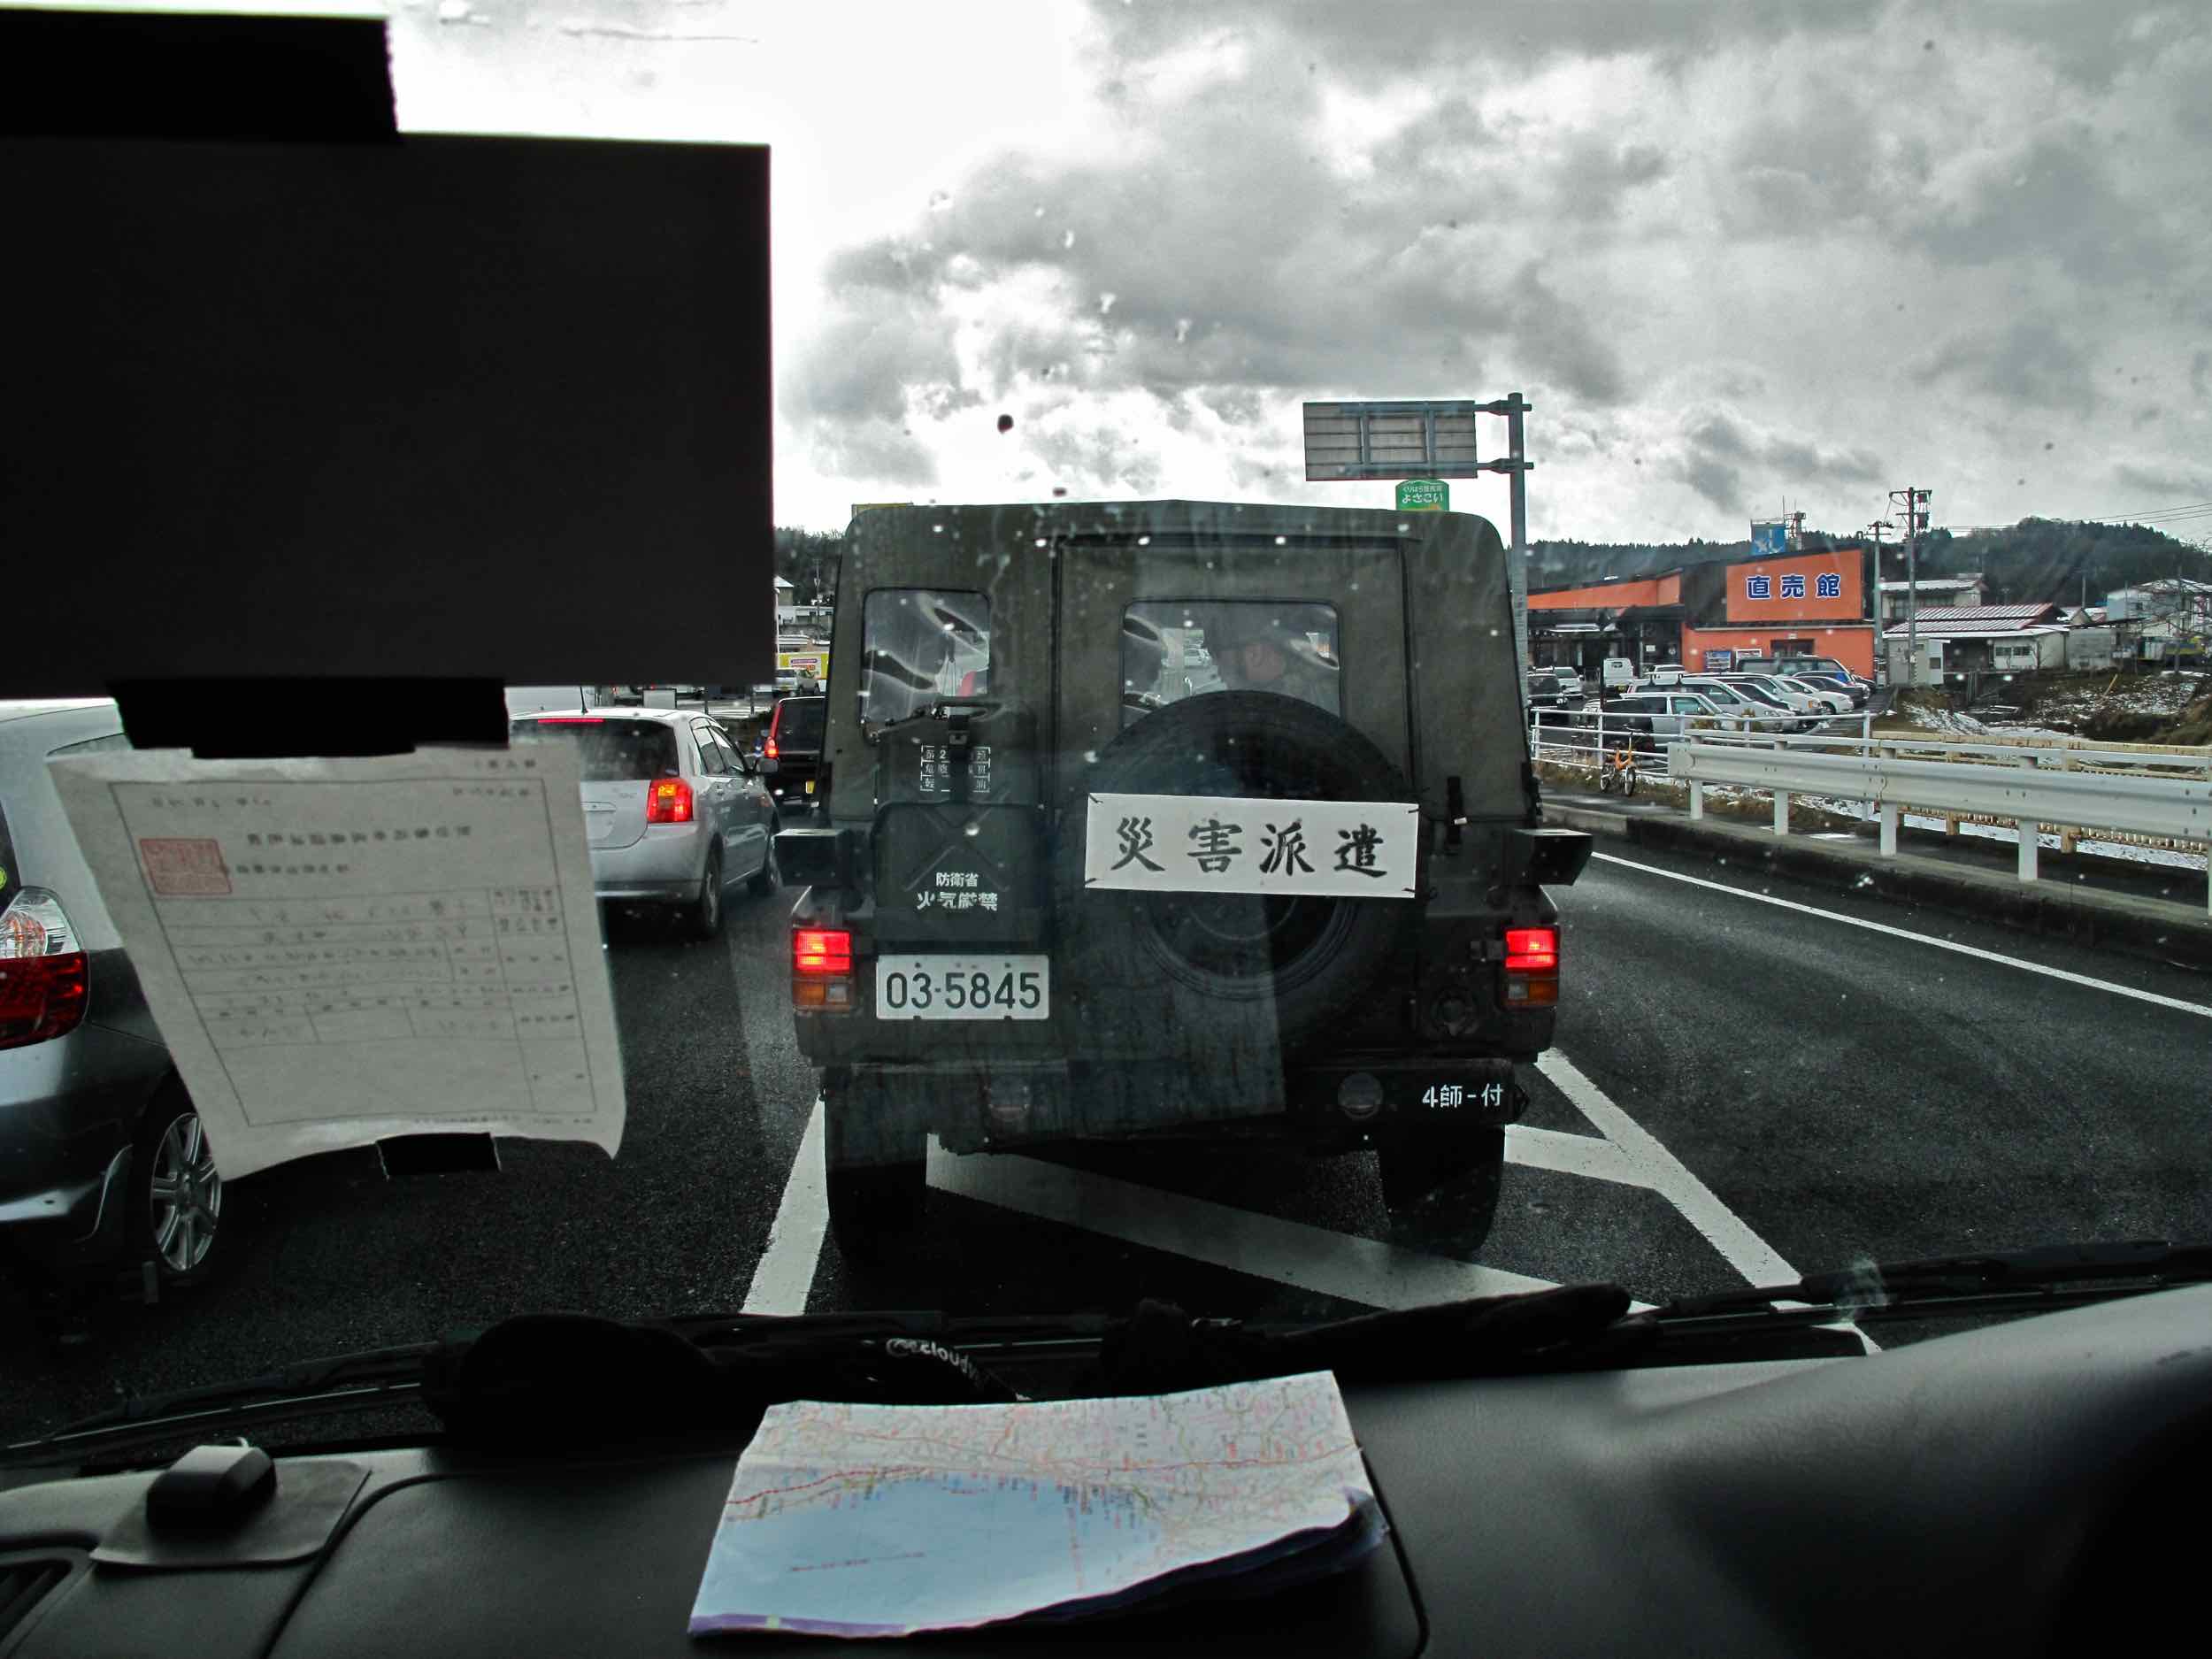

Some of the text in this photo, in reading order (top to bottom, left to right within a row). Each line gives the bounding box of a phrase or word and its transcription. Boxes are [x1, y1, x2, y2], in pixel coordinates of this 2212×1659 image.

[1402, 493, 1444, 503] よさこい
[1746, 572, 1841, 600] 直売館
[1110, 816, 1388, 879] 災害派遣
[935, 872, 979, 887] 防衛省
[916, 890, 998, 911] 火気厳禁
[886, 972, 1041, 1010] 03-5845
